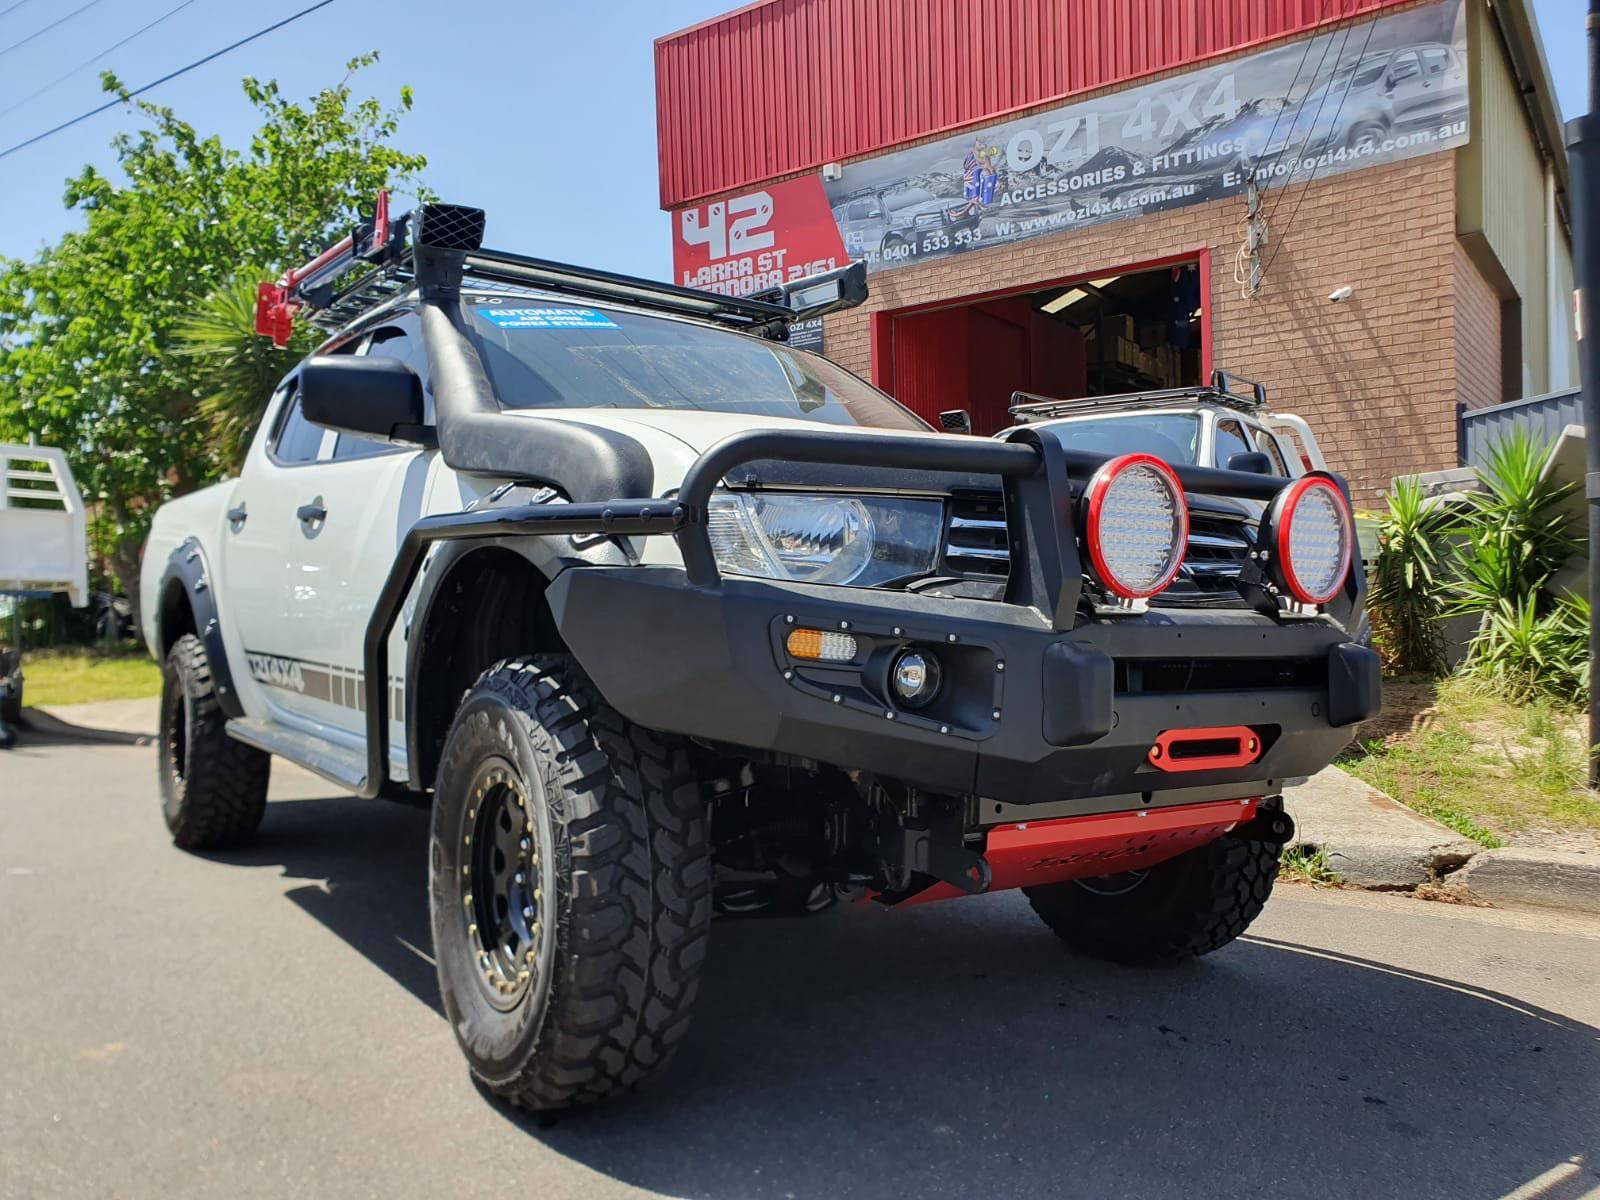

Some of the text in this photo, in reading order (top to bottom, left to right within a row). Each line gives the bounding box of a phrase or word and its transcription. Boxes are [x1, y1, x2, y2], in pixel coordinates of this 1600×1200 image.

[1006, 72, 1241, 172] OZI 4X4
[1000, 139, 1245, 207] ACCESSORIES & FITTINGS
[1222, 171, 1242, 188] E:
[681, 191, 775, 261] 42
[995, 184, 1195, 237] W: www.ozi4x4.com.au
[883, 242, 917, 263] 0401
[922, 235, 950, 252] 533
[954, 228, 982, 246] 333
[683, 249, 787, 288] LARRA ST
[490, 308, 595, 317] AUTOMATIC
[789, 319, 822, 332] OZI 4X4
